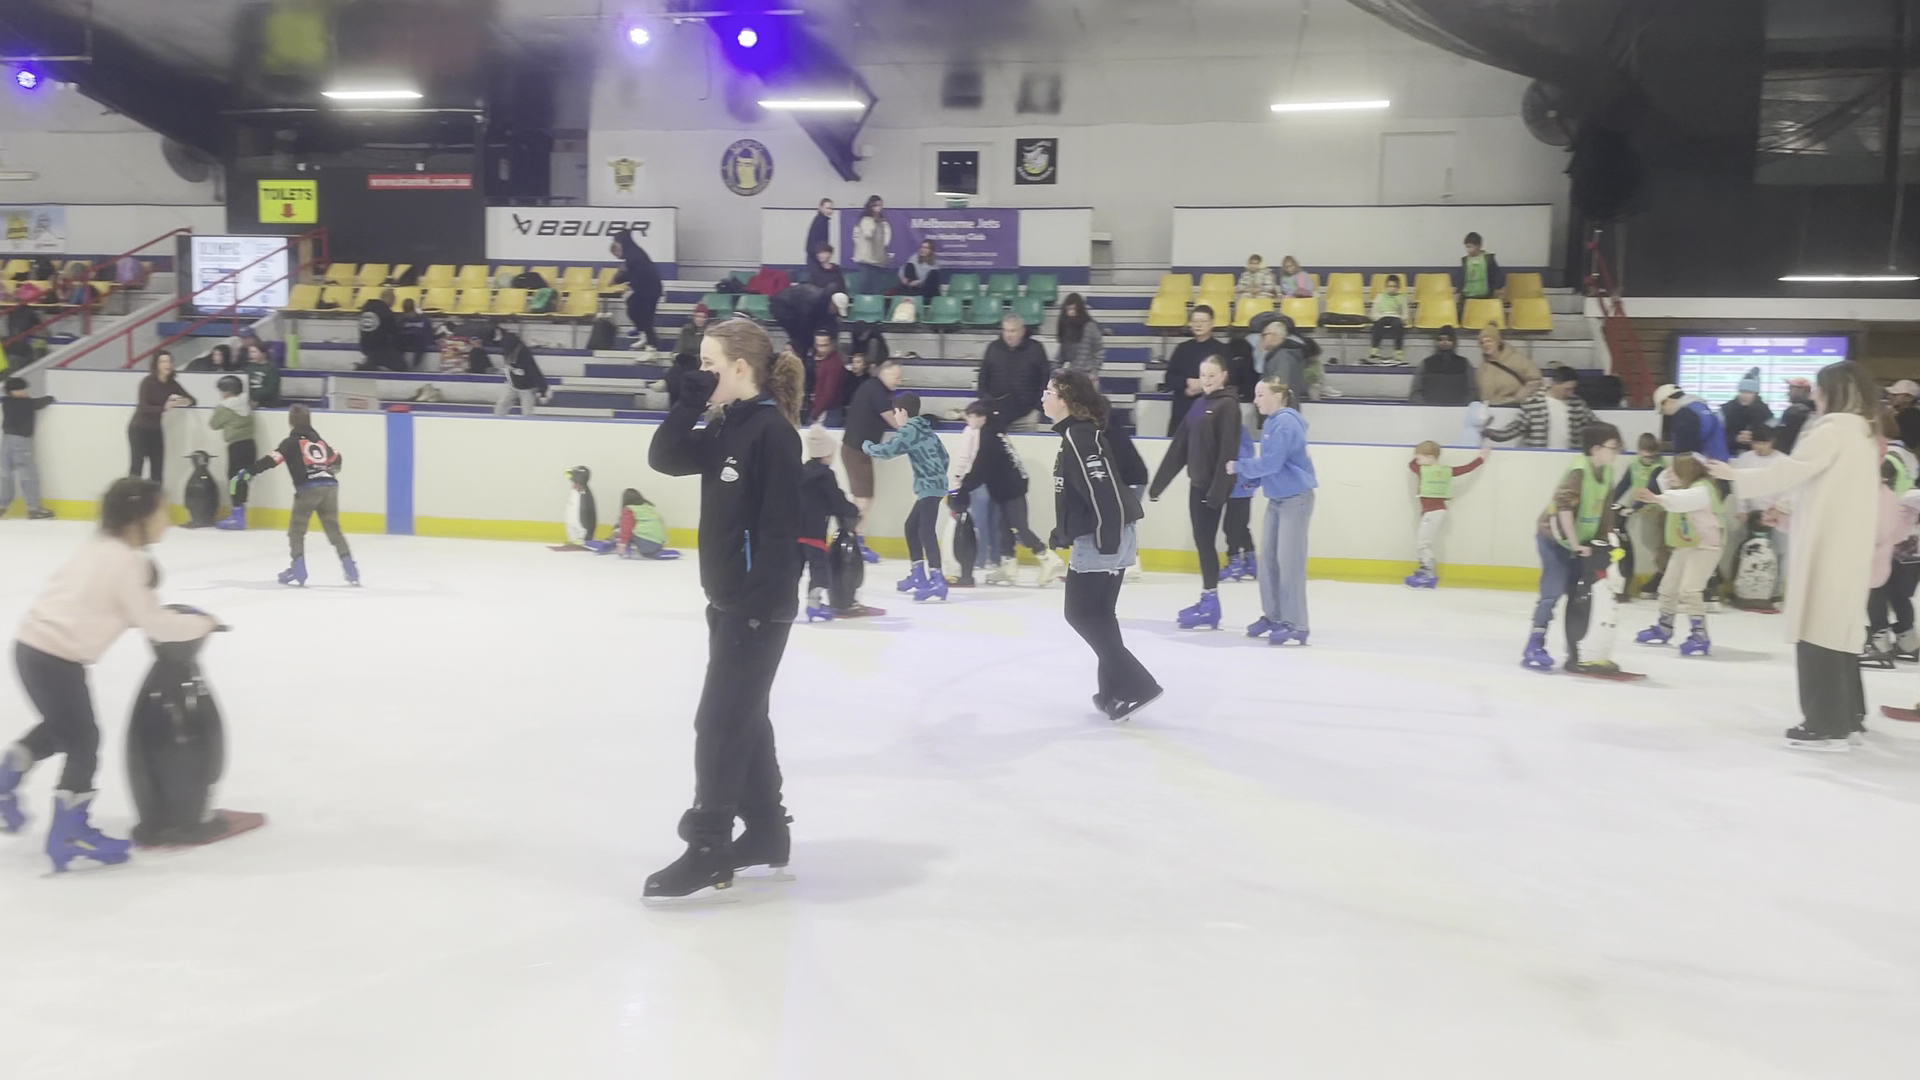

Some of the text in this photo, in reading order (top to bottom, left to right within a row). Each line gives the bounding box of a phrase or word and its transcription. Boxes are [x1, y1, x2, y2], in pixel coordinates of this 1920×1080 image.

[261, 187, 313, 201] TOILETS
[537, 219, 650, 237] BAUER
[911, 218, 1001, 229] Melbourne Jets
